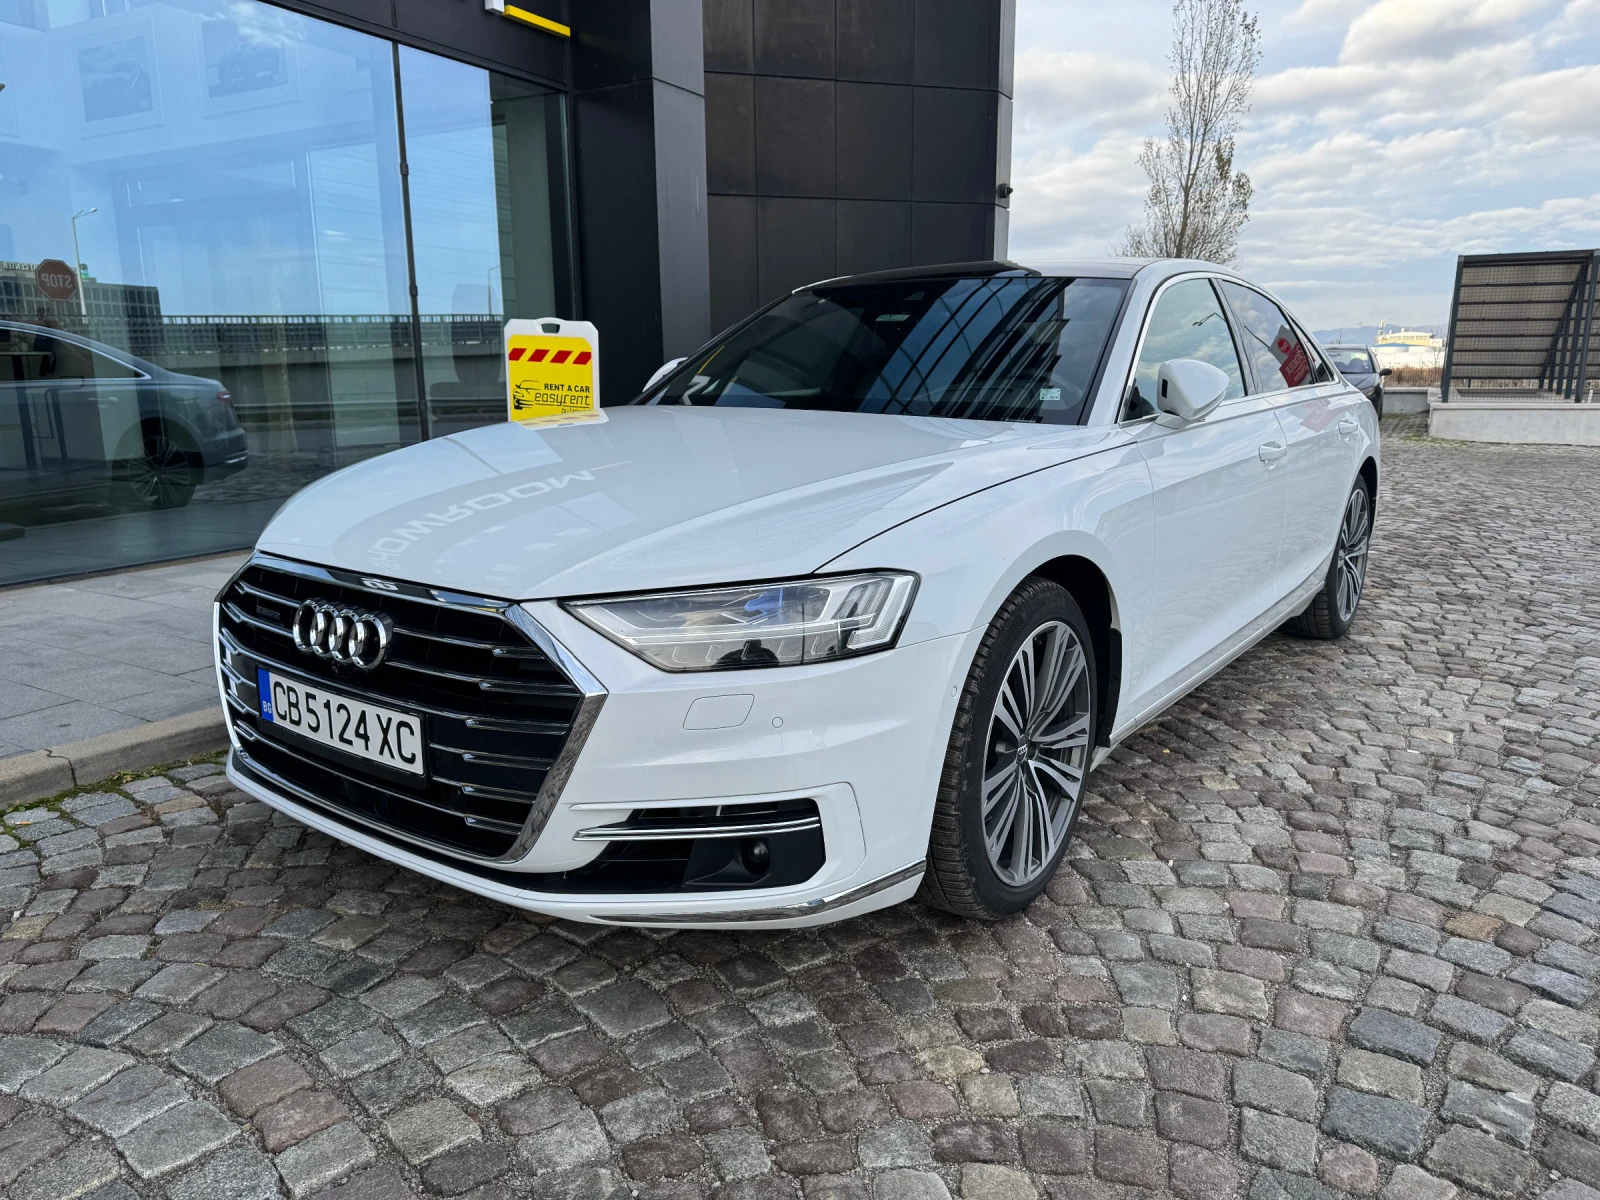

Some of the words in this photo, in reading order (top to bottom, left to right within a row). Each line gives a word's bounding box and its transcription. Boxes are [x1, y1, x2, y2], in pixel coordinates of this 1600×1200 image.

[544, 383, 565, 391] RENT
[567, 384, 574, 392] A
[574, 385, 590, 393] CAR
[534, 392, 590, 406] easyrent
[263, 700, 273, 714] BG
